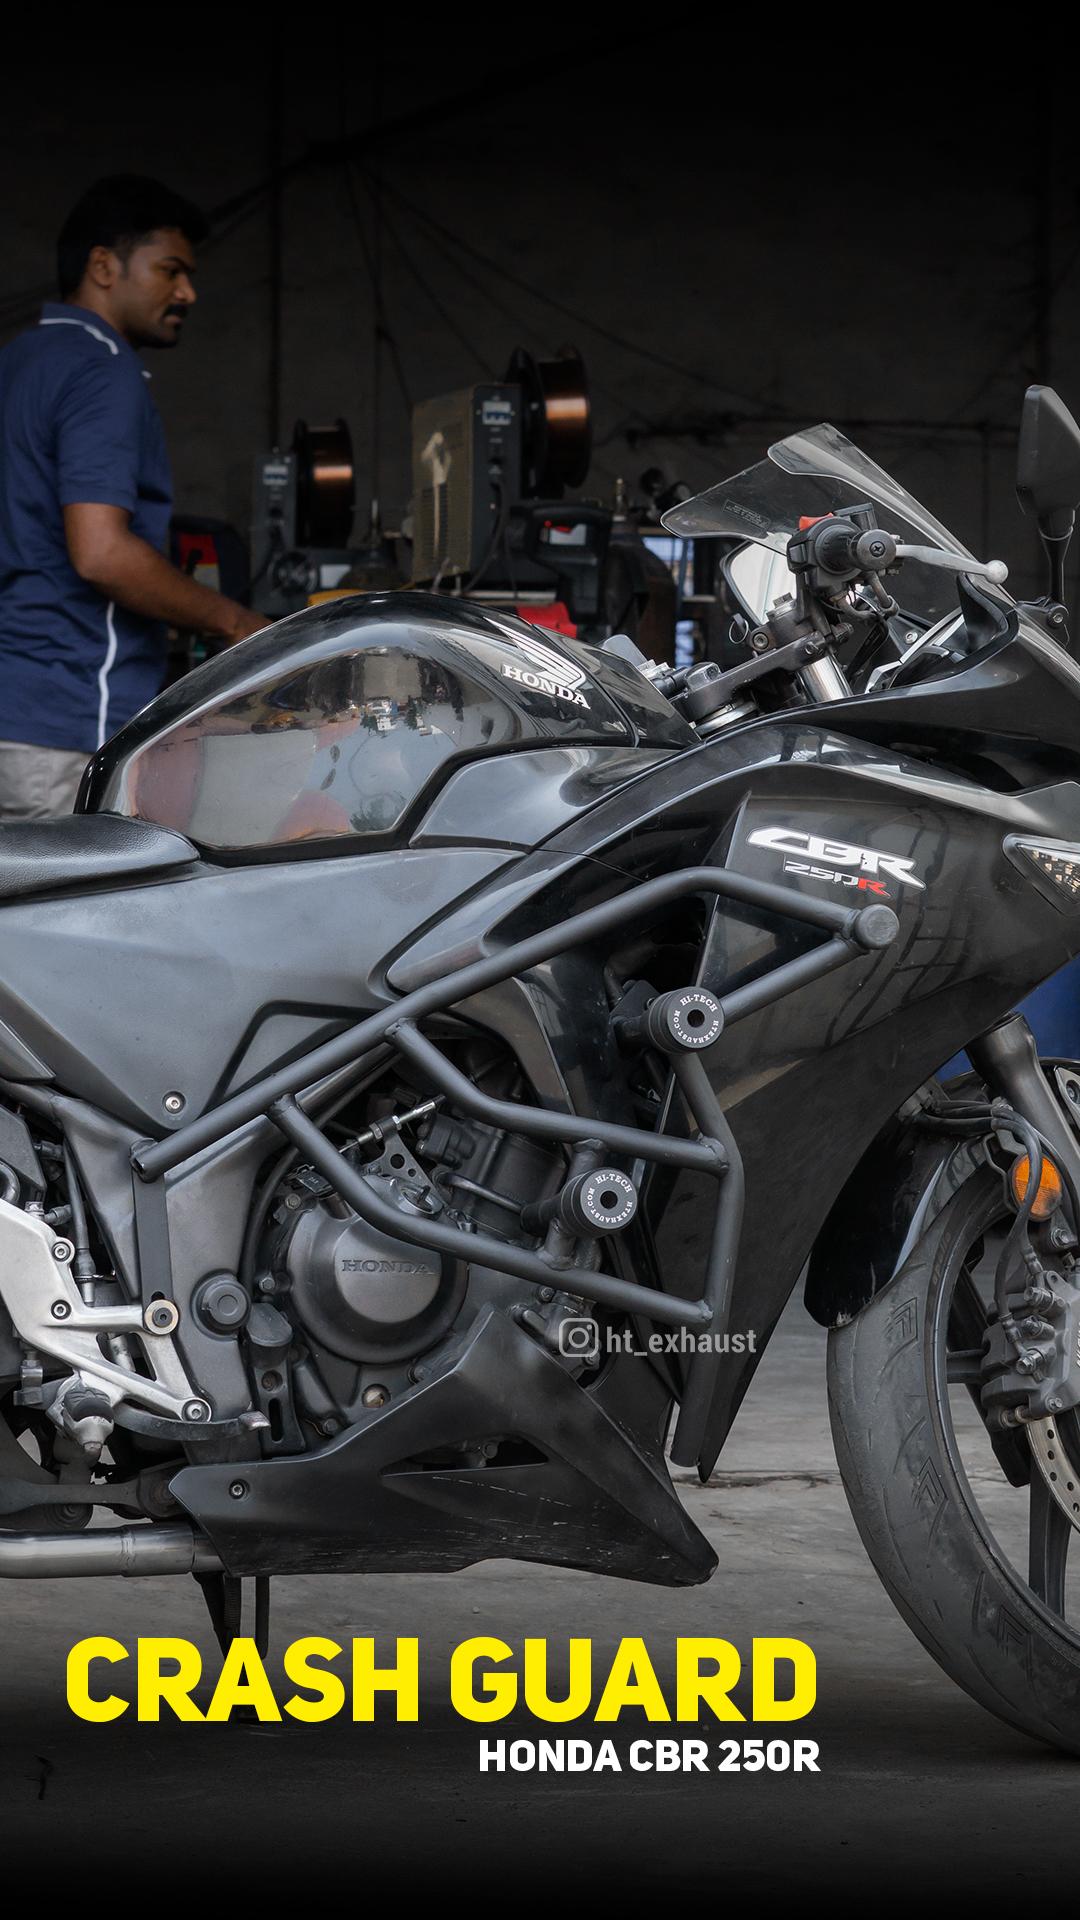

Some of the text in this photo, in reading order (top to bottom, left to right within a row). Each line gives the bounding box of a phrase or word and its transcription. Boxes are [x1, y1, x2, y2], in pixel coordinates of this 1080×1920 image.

[502, 664, 591, 710] HONDA
[748, 826, 926, 890] CBR
[784, 860, 892, 898] 250R
[680, 994, 718, 1012] HI-TECH
[673, 1010, 719, 1044] HTEXHAUST.COM
[595, 1173, 632, 1193] HI-TECH
[587, 1187, 633, 1223] HTEXHAUST.COM
[342, 1259, 439, 1275] HONDA
